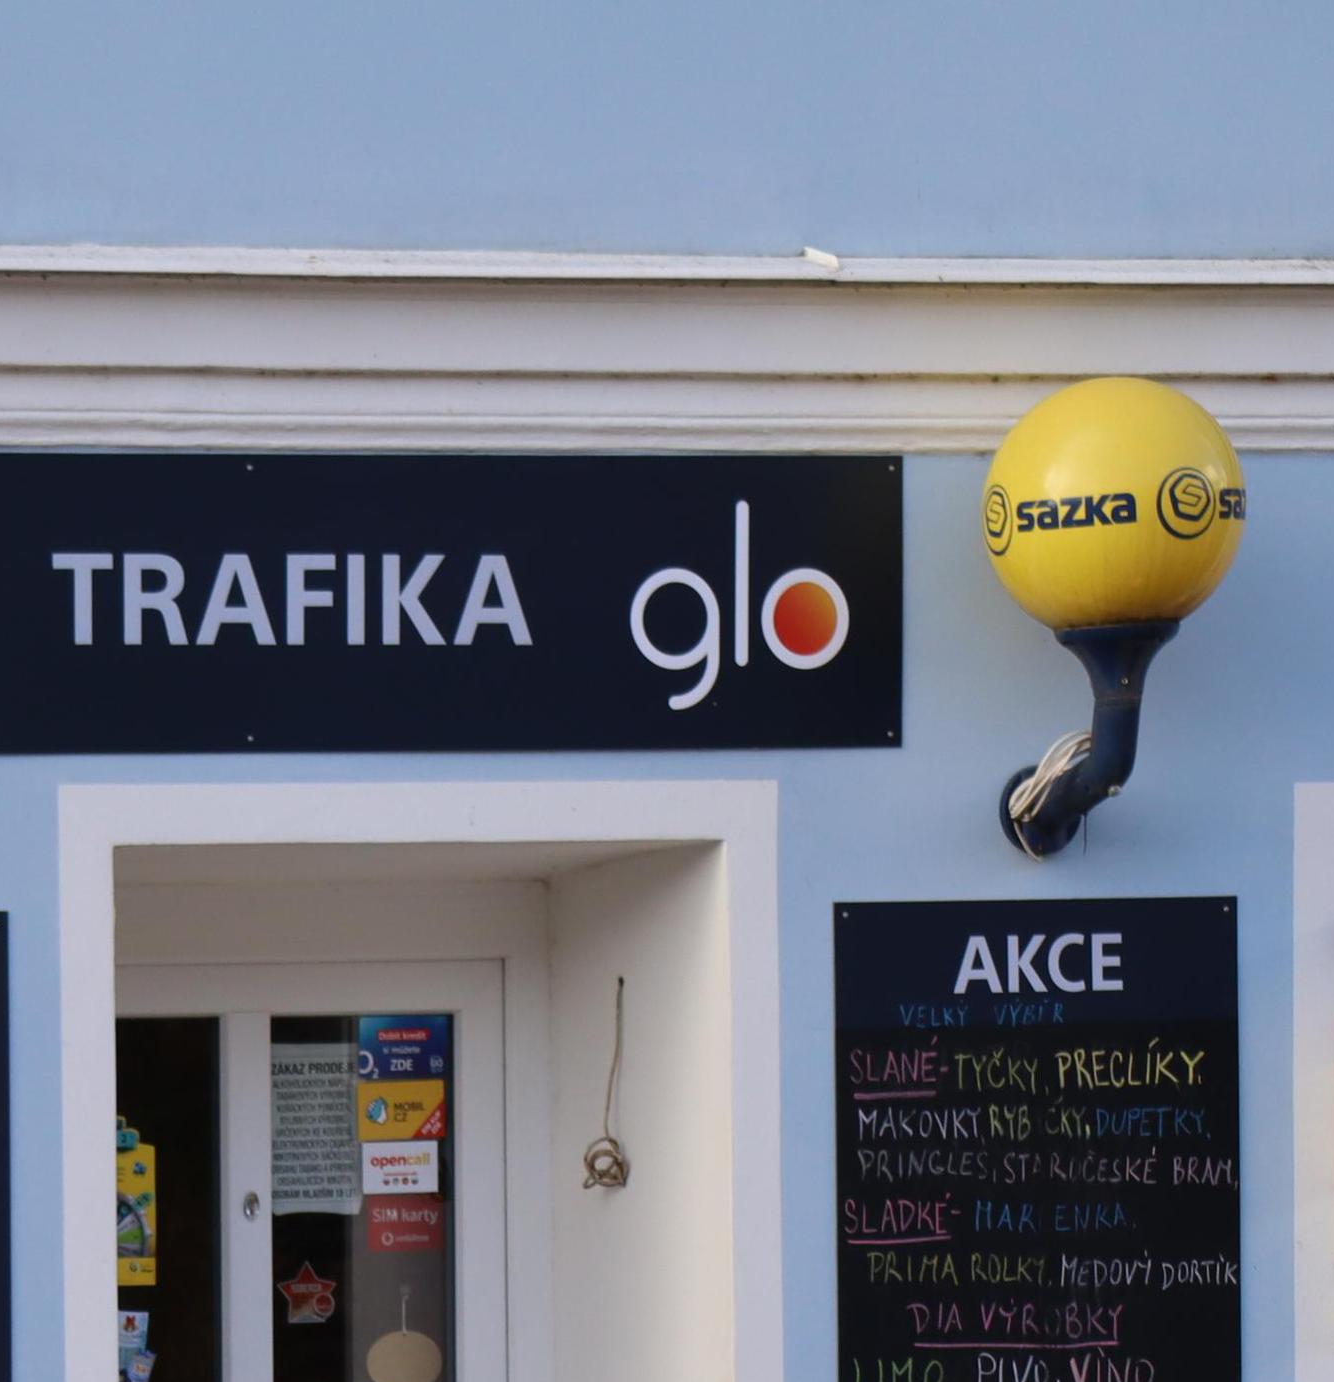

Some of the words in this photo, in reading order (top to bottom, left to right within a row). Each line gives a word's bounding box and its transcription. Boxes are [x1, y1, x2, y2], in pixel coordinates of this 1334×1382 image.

[52, 553, 533, 646] TRAFIKA
[630, 499, 850, 711] glo
[953, 933, 1124, 994] AKCE
[390, 1059, 414, 1072] ZDE
[370, 1153, 431, 1169] opencall
[373, 1209, 398, 1223] SIM
[401, 1208, 438, 1226] karty
[867, 1253, 959, 1286] PRIMA
[1060, 1250, 1151, 1289] MEDOVÝ
[906, 1302, 962, 1335] DIA
